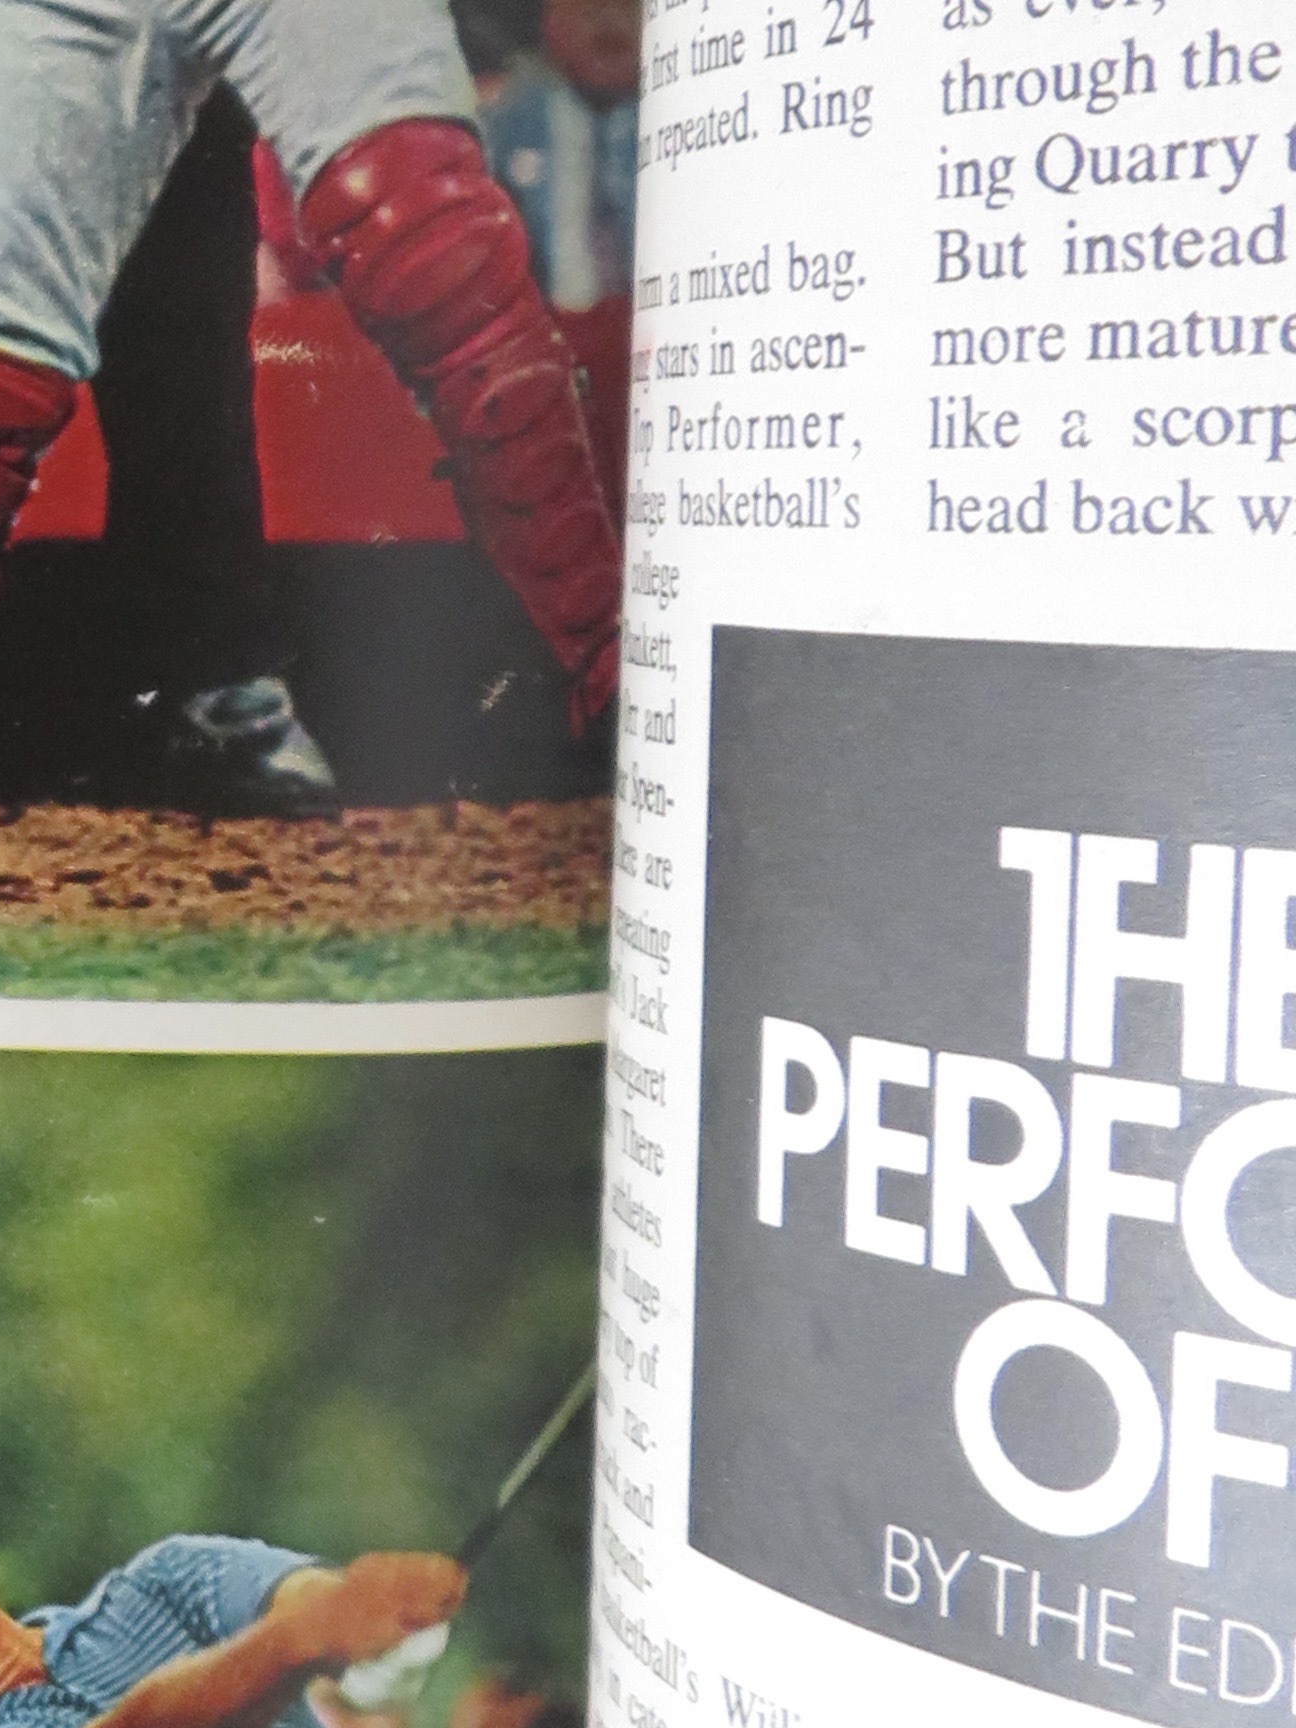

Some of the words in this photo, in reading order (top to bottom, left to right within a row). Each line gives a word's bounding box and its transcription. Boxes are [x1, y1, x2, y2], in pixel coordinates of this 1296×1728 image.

[689, 23, 746, 77] time
[762, 4, 799, 60] in
[939, 35, 1158, 117] through
[1179, 26, 1282, 91] the
[655, 88, 759, 173] repeated.
[778, 74, 874, 139] Ring
[935, 143, 1017, 212] ing
[1032, 131, 1260, 196] Quarry
[687, 242, 772, 303] mixed
[785, 238, 867, 303] bag.
[933, 226, 1028, 285] But
[1062, 202, 1288, 276] instead
[708, 325, 736, 377] in
[748, 330, 866, 374] ascen-
[929, 321, 1067, 367] more
[665, 399, 862, 459] Performer,
[927, 393, 1020, 450] like
[1059, 408, 1092, 449] a
[926, 476, 1049, 535] head
[1069, 476, 1215, 536] back
[998, 826, 1296, 1091] THE
[953, 1298, 1294, 1569] OF
[884, 1524, 970, 1618] BY
[978, 1553, 1137, 1675] THE
